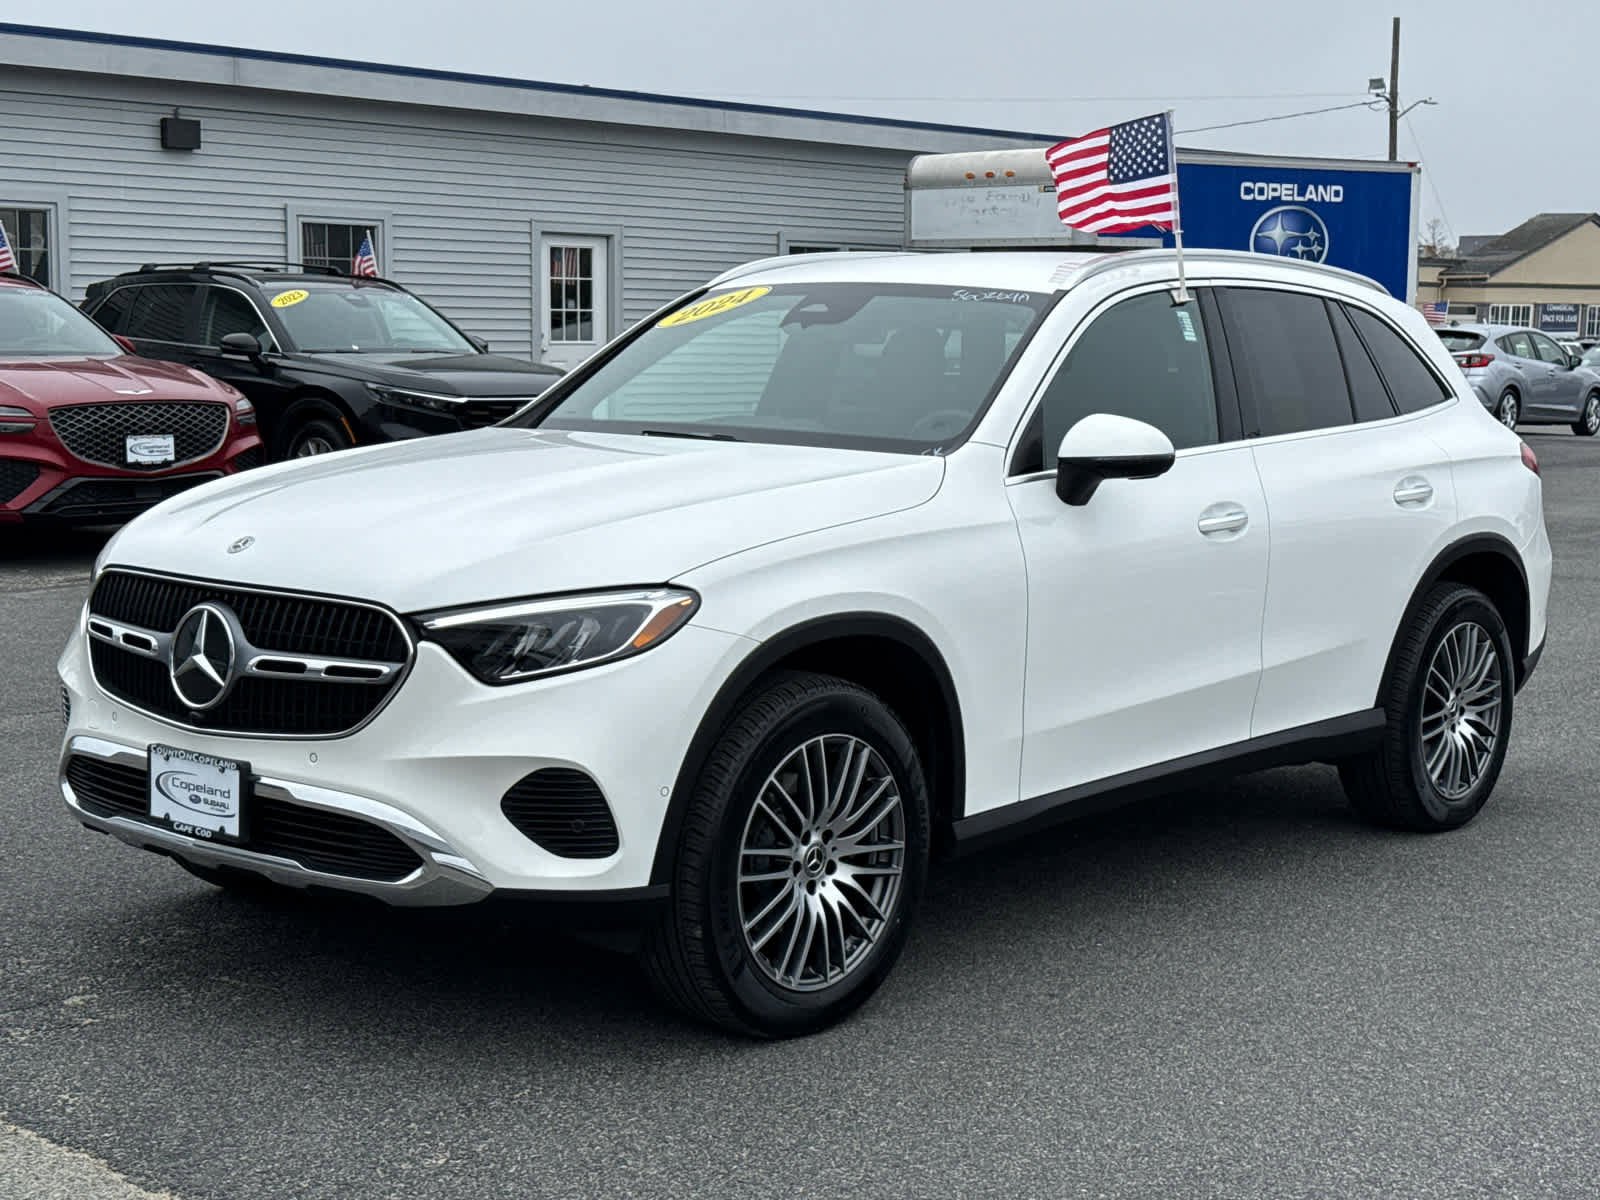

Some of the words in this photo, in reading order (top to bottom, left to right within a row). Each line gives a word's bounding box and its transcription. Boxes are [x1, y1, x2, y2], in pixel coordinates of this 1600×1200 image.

[1240, 182, 1344, 203] COPELAND
[278, 291, 304, 305] 2023
[673, 289, 755, 324] 2024
[171, 777, 231, 799] Copeland
[203, 798, 230, 810] SUBARU
[173, 821, 193, 834] CAPE
[195, 827, 213, 838] COD
